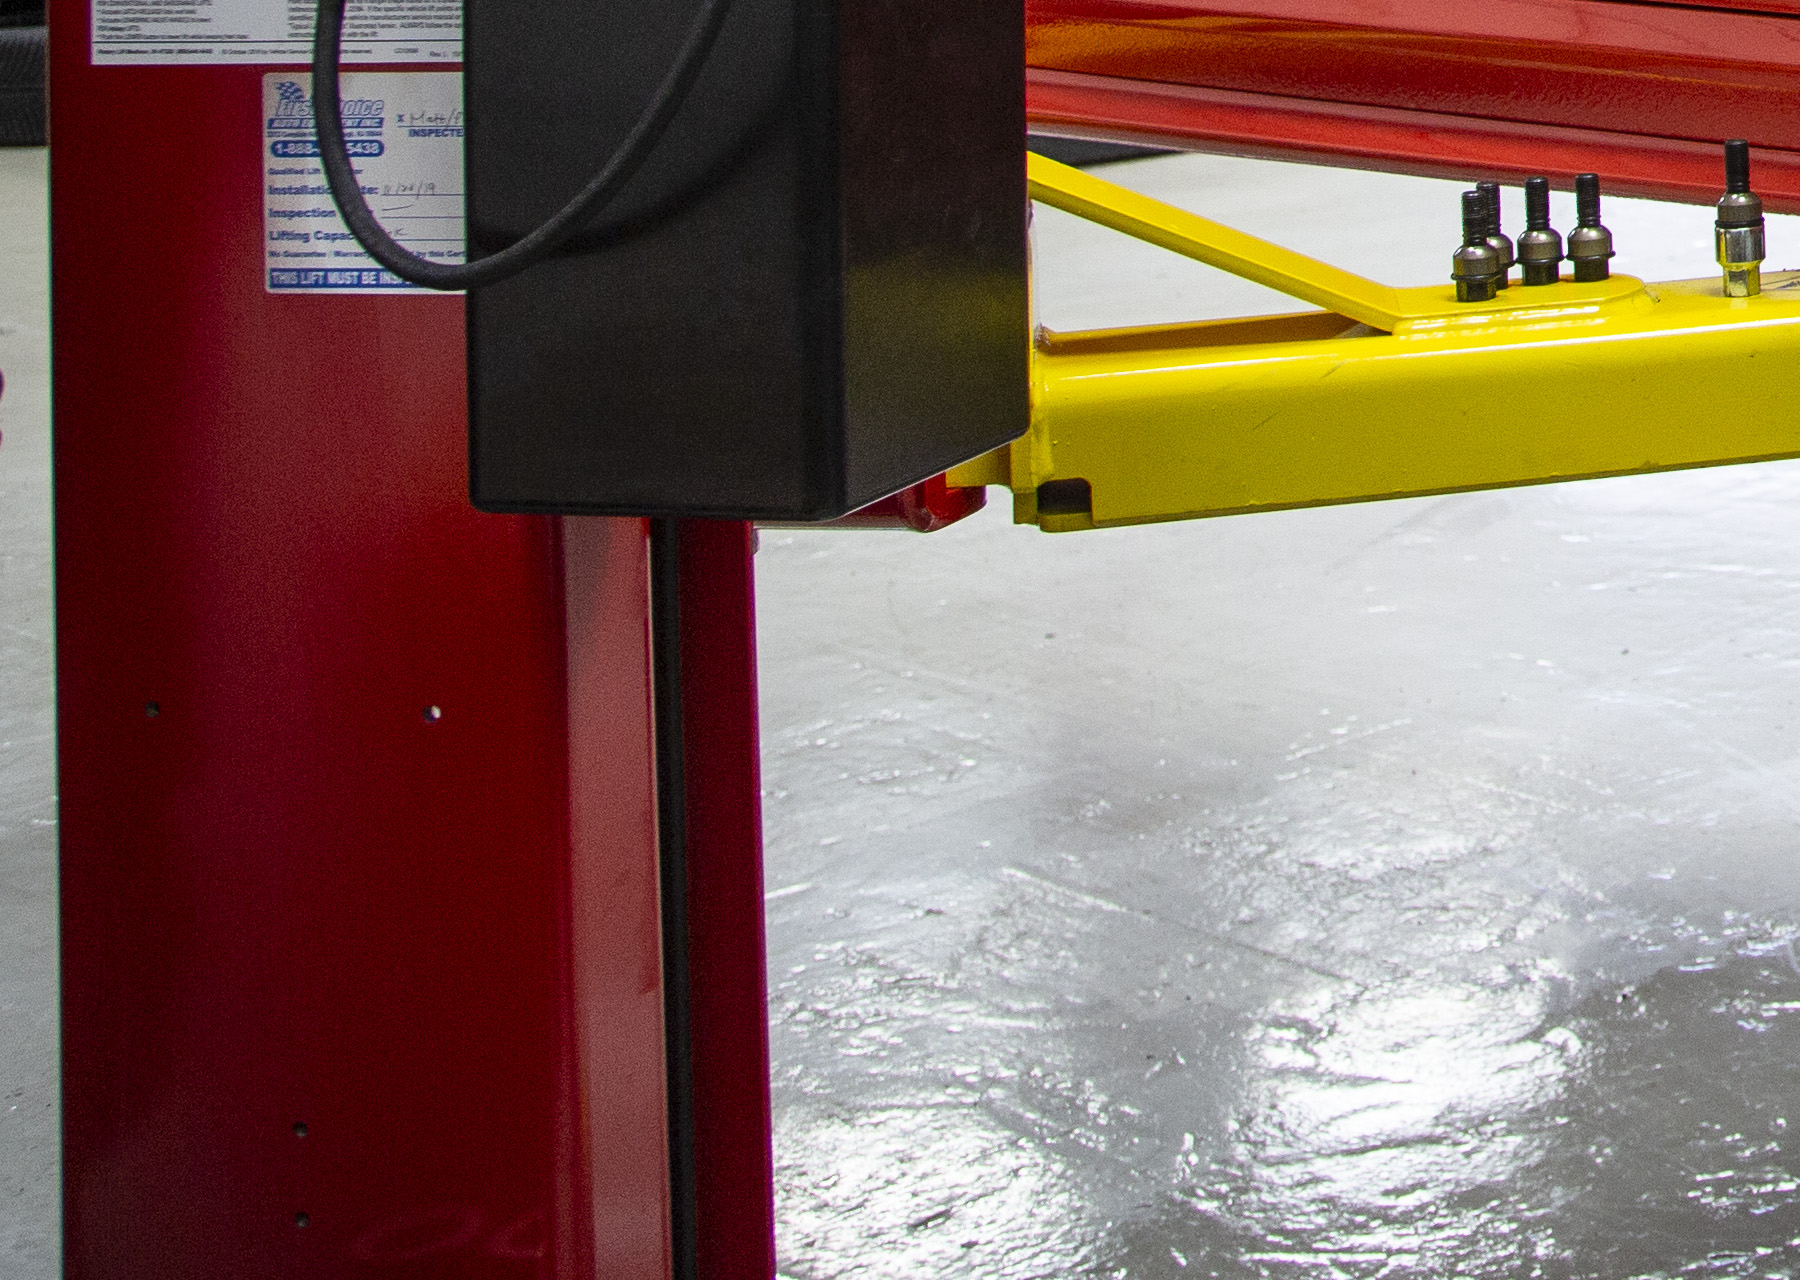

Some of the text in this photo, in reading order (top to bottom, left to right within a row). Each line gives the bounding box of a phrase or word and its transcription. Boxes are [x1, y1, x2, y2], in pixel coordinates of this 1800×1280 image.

[275, 99, 315, 117] Firs
[408, 129, 465, 138] INSPECTE
[268, 207, 336, 220] Inspection
[268, 230, 311, 244] Lifting
[300, 271, 325, 285] LIFT
[326, 271, 360, 285] MUST
[361, 271, 378, 285] BE
